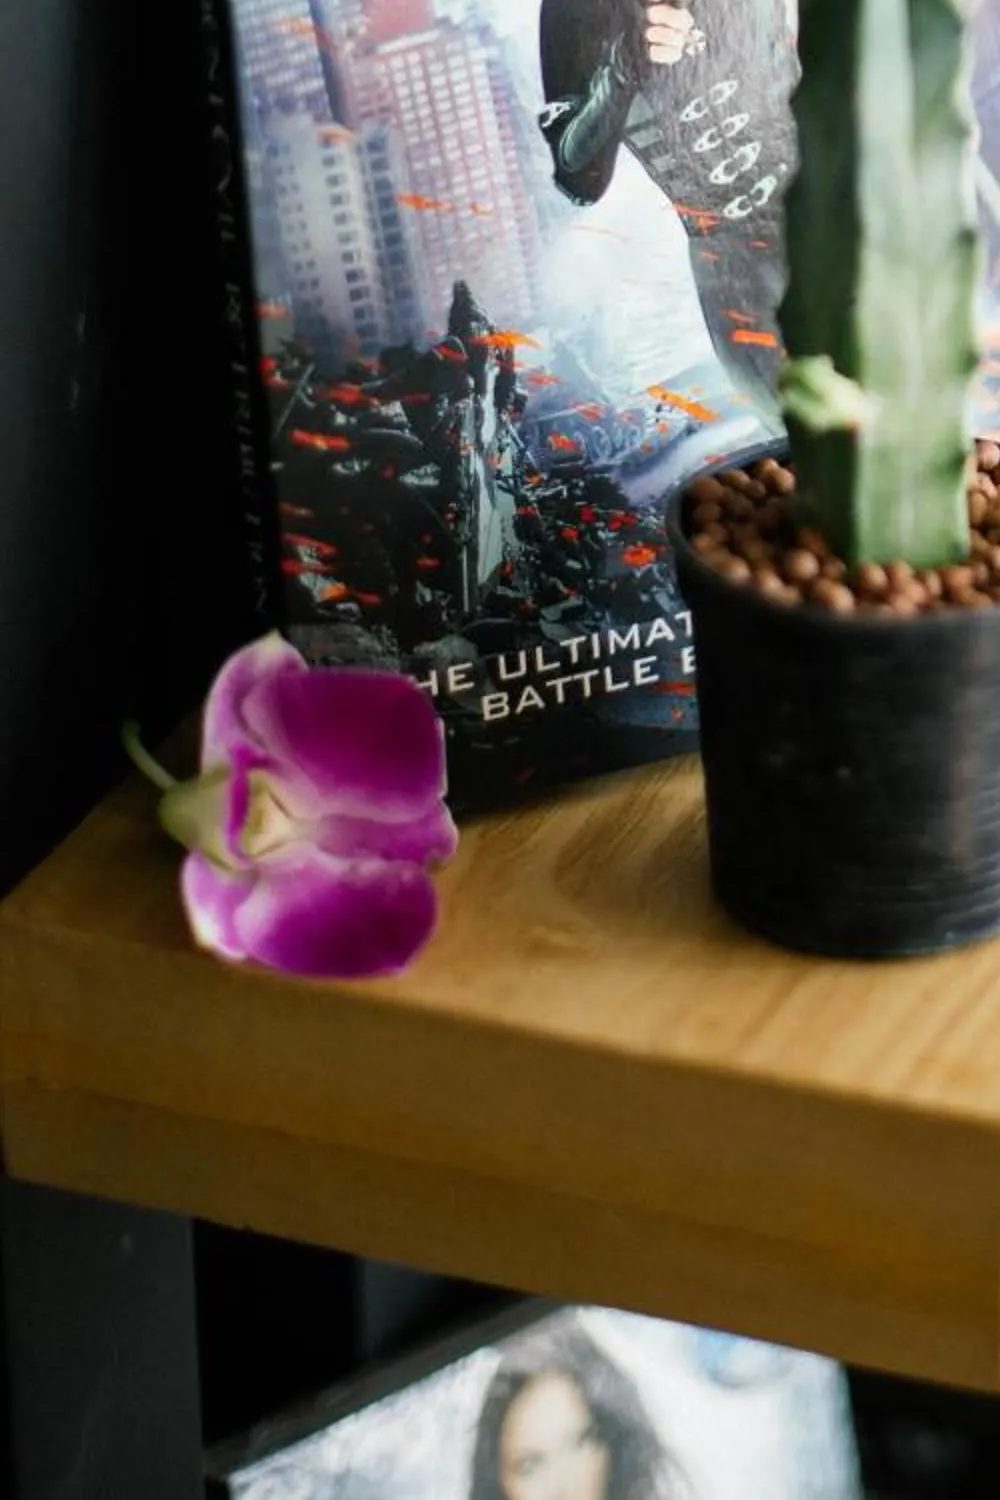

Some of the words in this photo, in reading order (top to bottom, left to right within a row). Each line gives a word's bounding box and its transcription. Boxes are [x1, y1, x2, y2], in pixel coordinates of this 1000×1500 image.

[408, 661, 475, 698] HE
[499, 610, 694, 682] ULTIMAT
[481, 655, 660, 722] BATTLE
